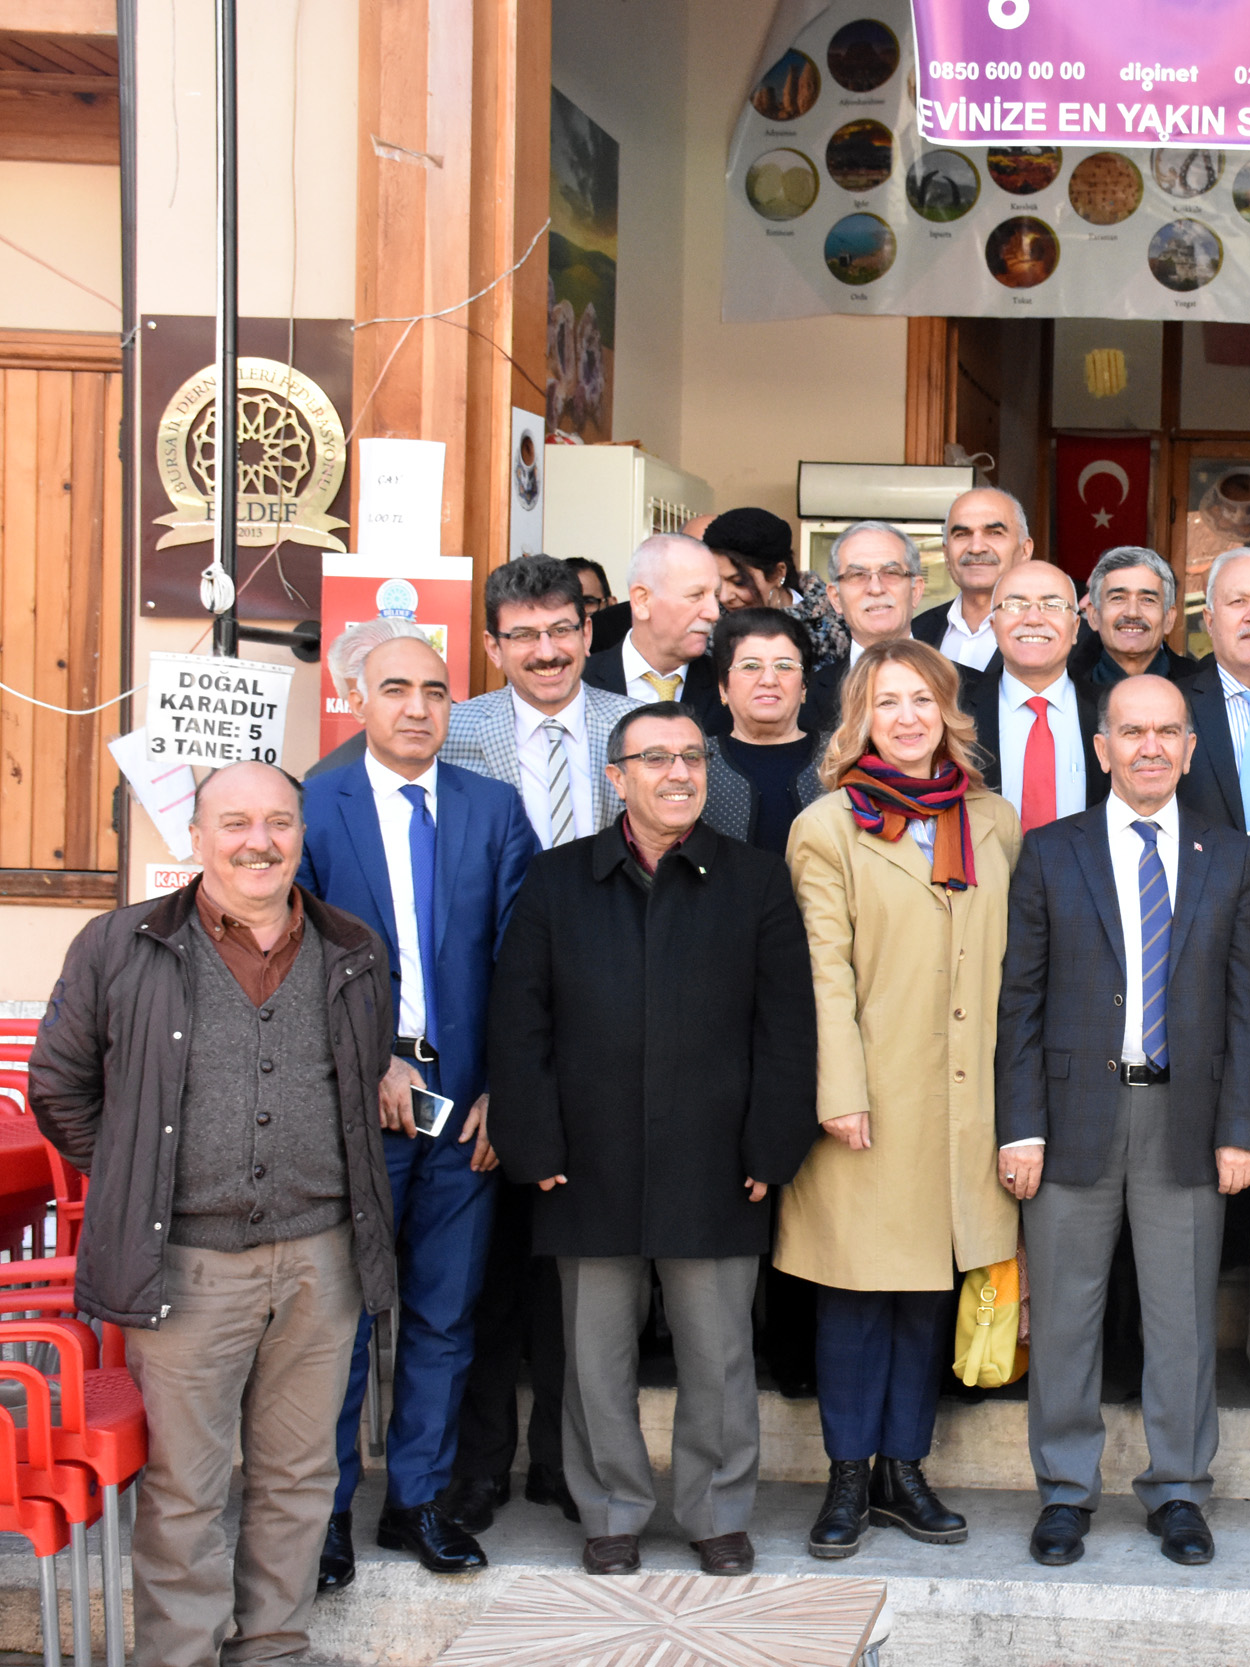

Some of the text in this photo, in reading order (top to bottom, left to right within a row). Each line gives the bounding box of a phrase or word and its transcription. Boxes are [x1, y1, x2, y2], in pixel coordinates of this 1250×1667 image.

[929, 61, 979, 80] 0850
[985, 61, 1022, 80] 600
[1028, 61, 1054, 80] 00
[1060, 62, 1085, 80] 00
[1119, 62, 1199, 91] diginet
[919, 96, 1046, 132] EVİNİZE
[1059, 103, 1106, 132] EN
[1116, 103, 1225, 135] YAKIN
[165, 437, 187, 493] BURSA
[176, 367, 277, 414] DERNLERİ
[205, 501, 297, 522] BLDEF
[238, 528, 263, 538] 2013
[179, 670, 264, 696] DOĞAL
[160, 693, 278, 719] KARADUT
[172, 716, 262, 740] TANE: 5
[151, 738, 276, 763] 3 TANE: 10
